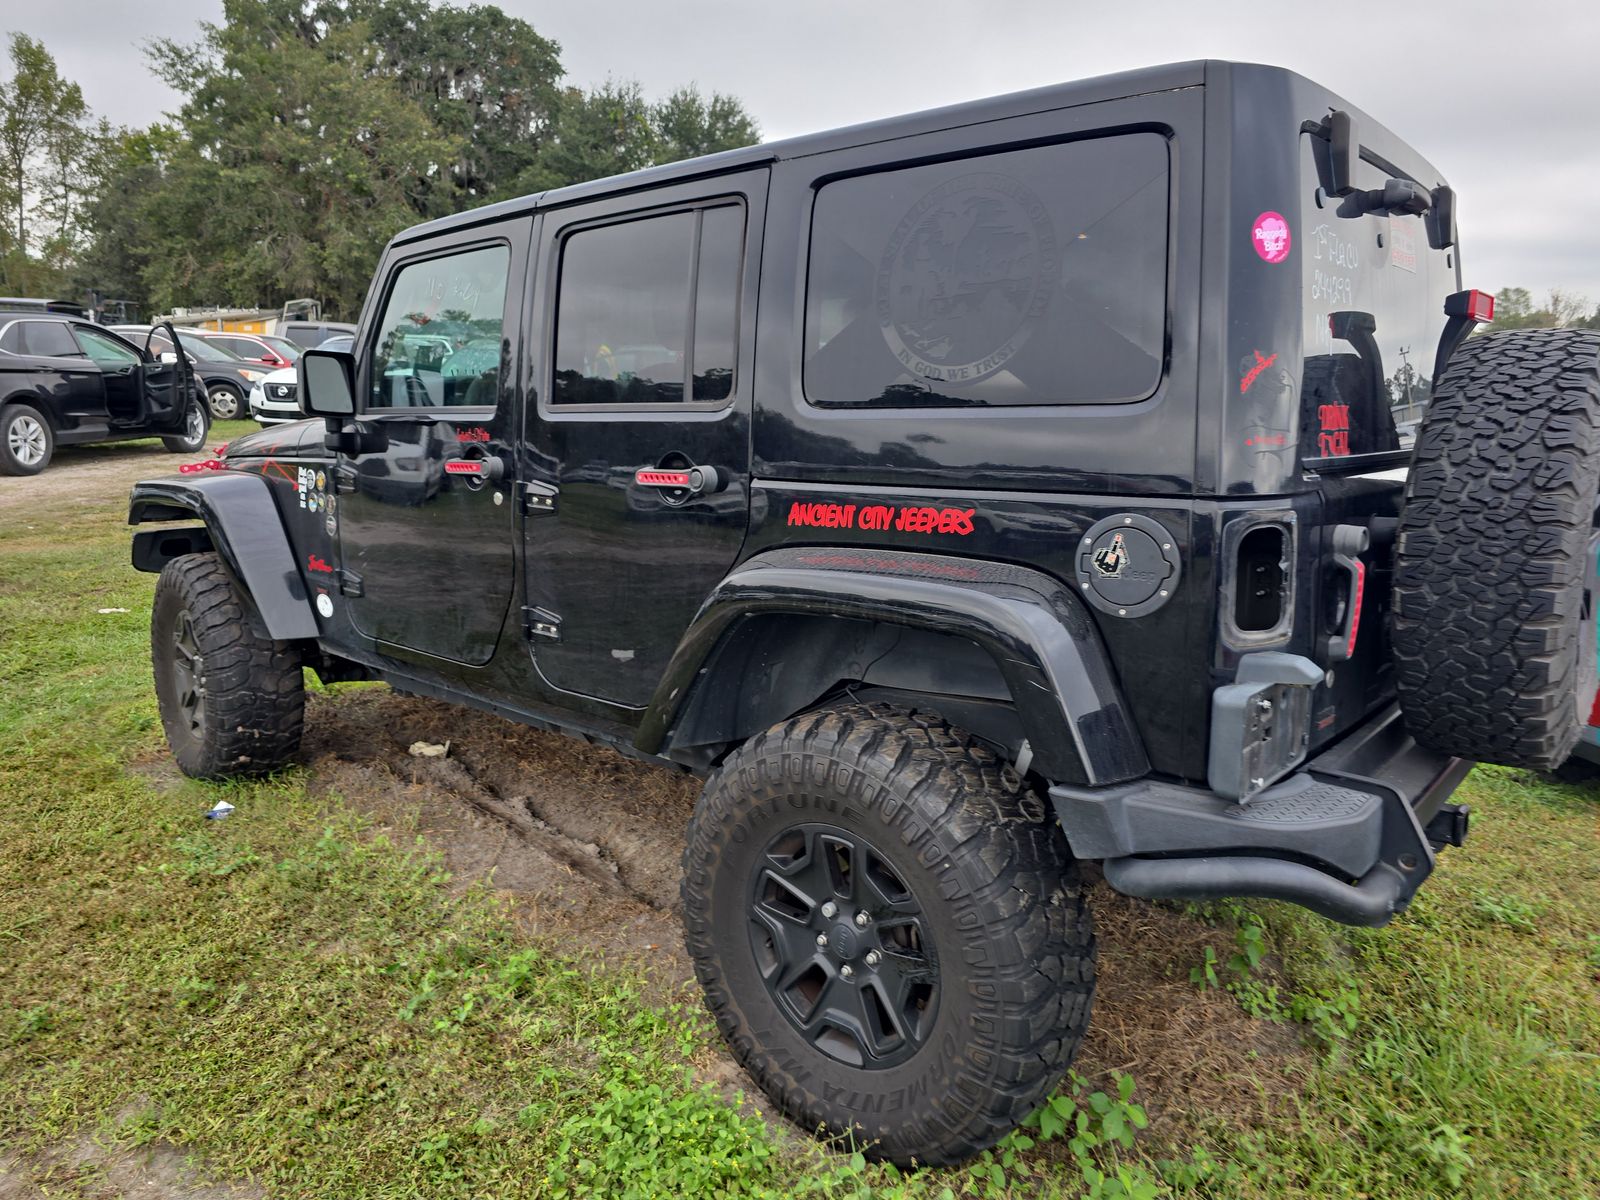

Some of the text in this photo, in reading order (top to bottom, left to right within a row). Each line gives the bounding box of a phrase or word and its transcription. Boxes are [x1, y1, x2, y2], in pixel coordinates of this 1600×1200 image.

[897, 342, 1017, 380] IN GOD WE TRUST
[787, 502, 976, 536] ANCIENT CITY JEEPERS
